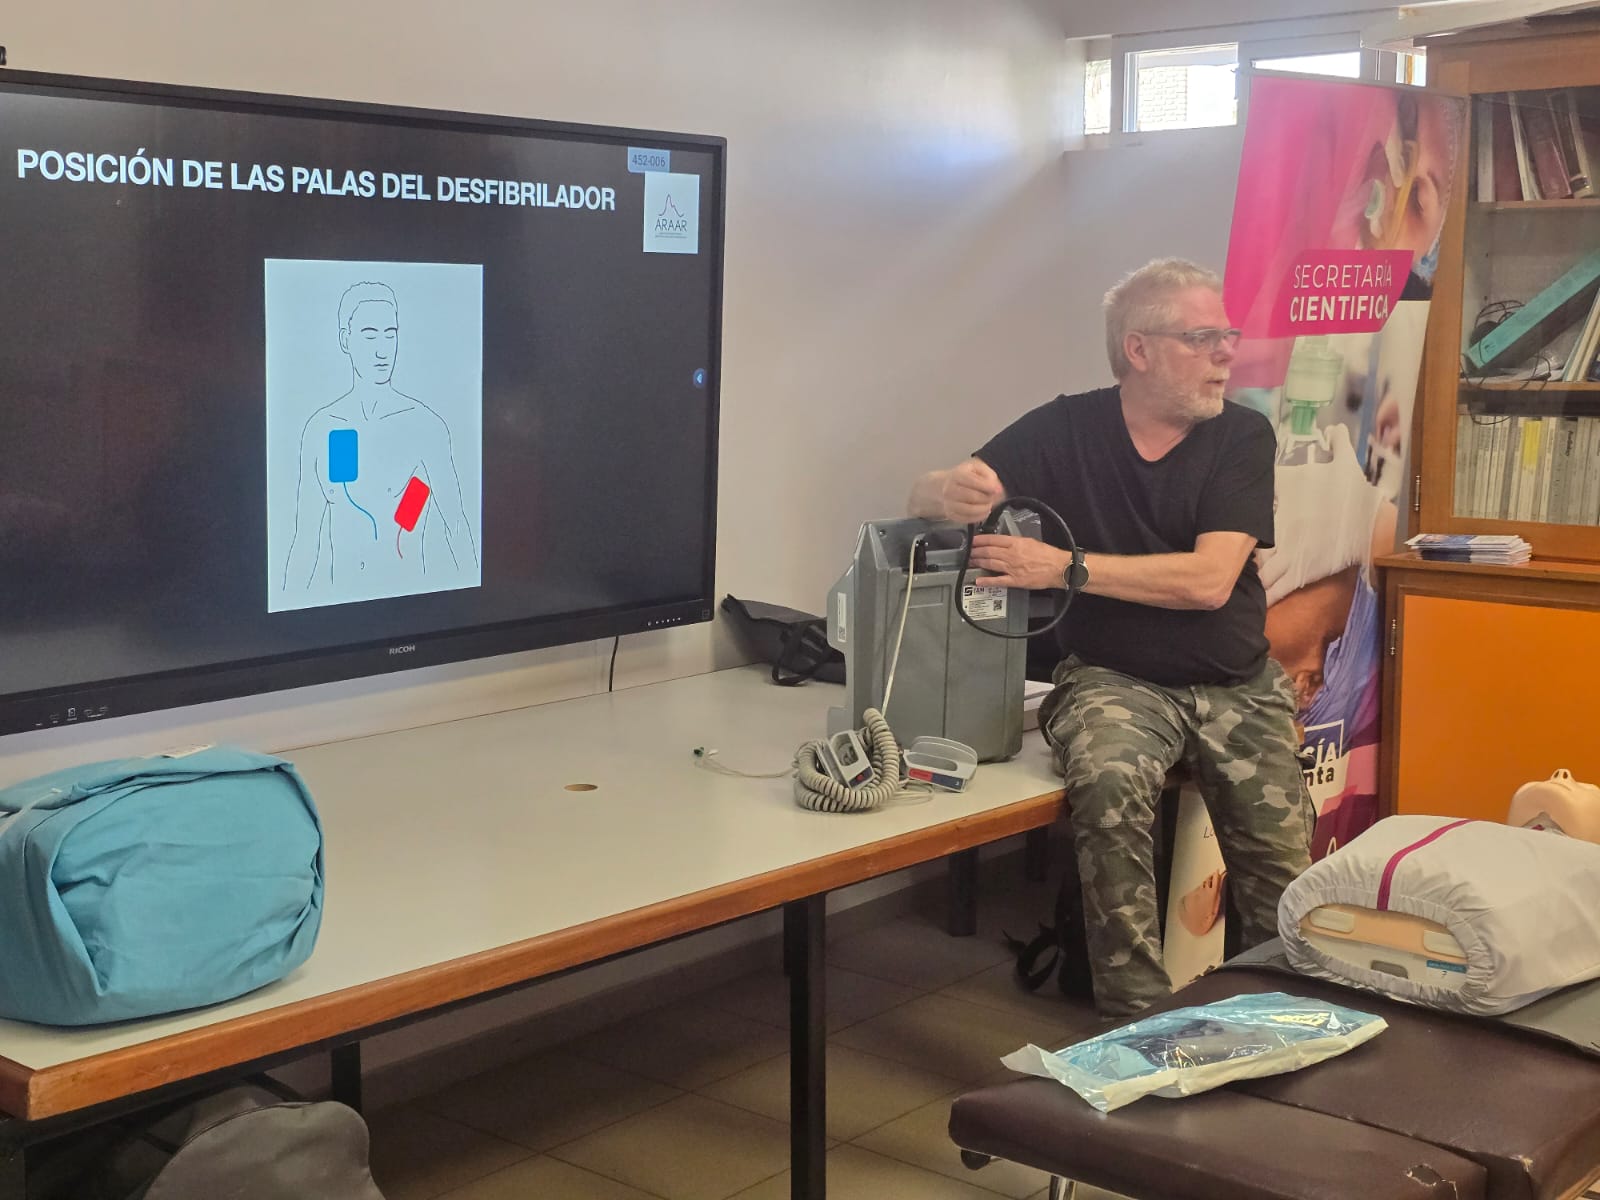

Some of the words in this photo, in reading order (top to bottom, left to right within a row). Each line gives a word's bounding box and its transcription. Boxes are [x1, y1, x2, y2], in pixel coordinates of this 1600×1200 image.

[632, 154, 666, 167] 452-006
[17, 147, 174, 187] POSICIÓN
[182, 159, 224, 189] DE
[230, 162, 285, 193] LAS
[291, 166, 376, 198] PALAS
[382, 172, 432, 201] DEL
[437, 175, 616, 211] DESFIBRILADOR
[654, 218, 688, 232] ARAAR
[1293, 259, 1393, 288] SECRETARÍA
[1289, 294, 1389, 322] CIENTIFICA
[389, 644, 416, 655] RICOH
